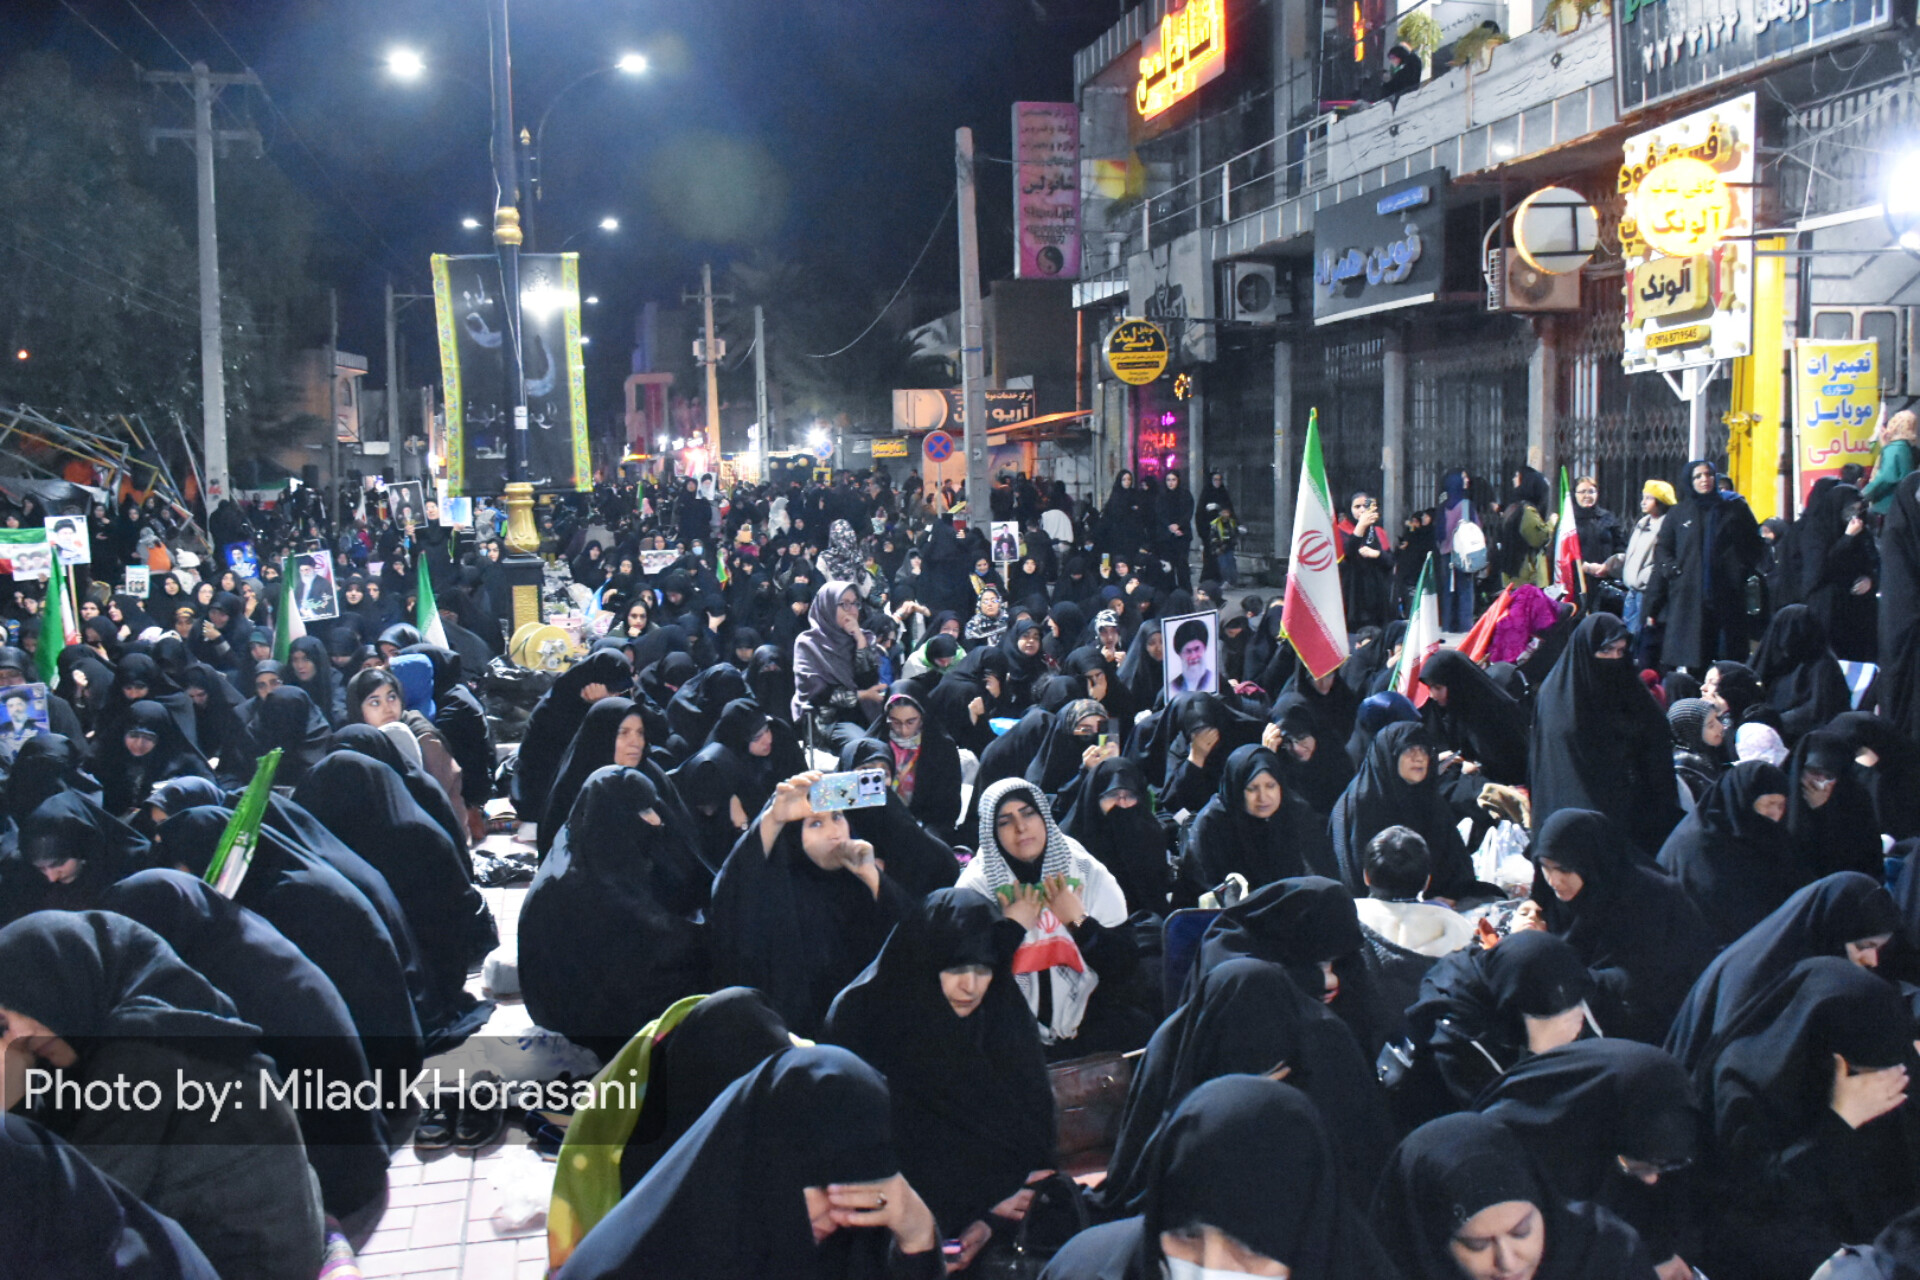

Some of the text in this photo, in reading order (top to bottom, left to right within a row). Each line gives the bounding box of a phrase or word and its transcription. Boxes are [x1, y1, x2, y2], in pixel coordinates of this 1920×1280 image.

[1651, 205, 1723, 243] آلونک
[1367, 224, 1421, 286] نوین
[1640, 259, 1692, 306] آلونک
[1806, 398, 1873, 426] موبایل
